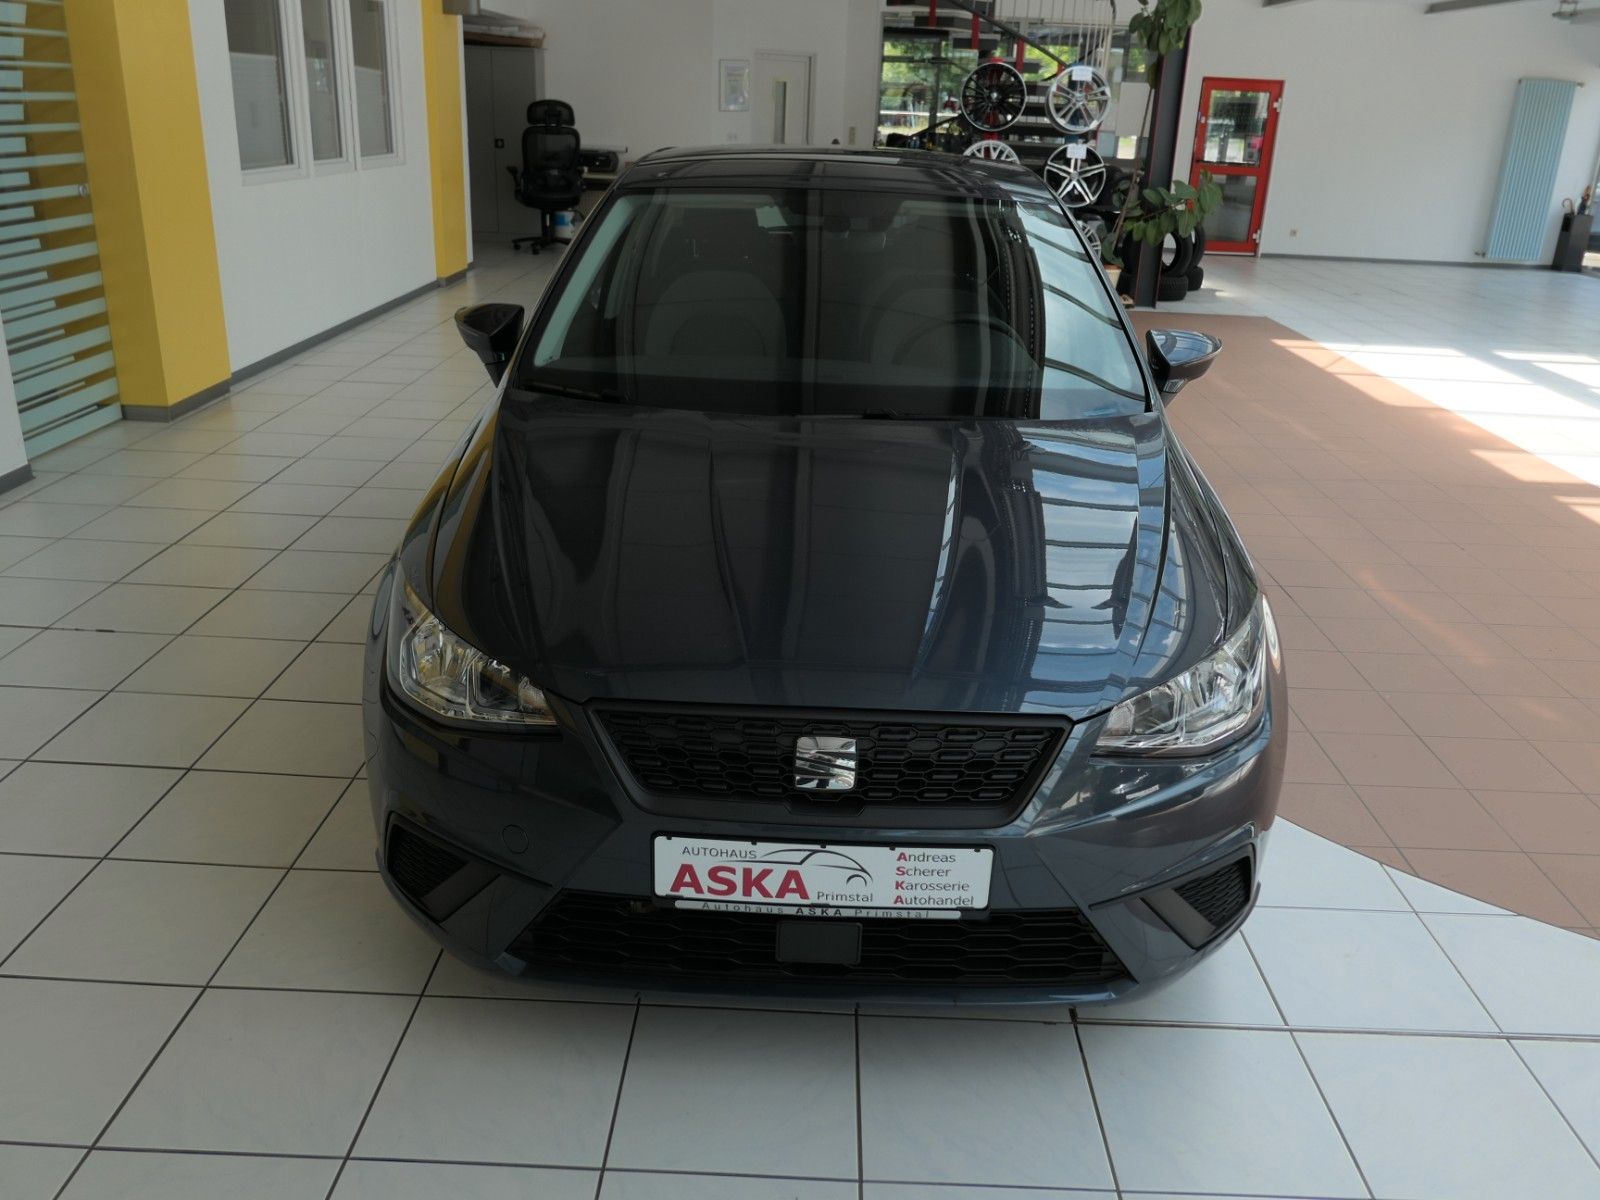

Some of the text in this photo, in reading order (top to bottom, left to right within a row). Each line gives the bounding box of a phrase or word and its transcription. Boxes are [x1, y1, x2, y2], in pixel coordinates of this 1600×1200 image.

[682, 846, 758, 860] AUTOHAUS
[896, 852, 956, 863] Andreas
[895, 866, 952, 877] Scherer
[670, 863, 810, 900] ASKA
[894, 880, 970, 891] Karosserie
[817, 891, 873, 902] Primstal
[893, 895, 974, 906] Autohandel
[702, 901, 930, 919] Autohaus ASKA Primstal
